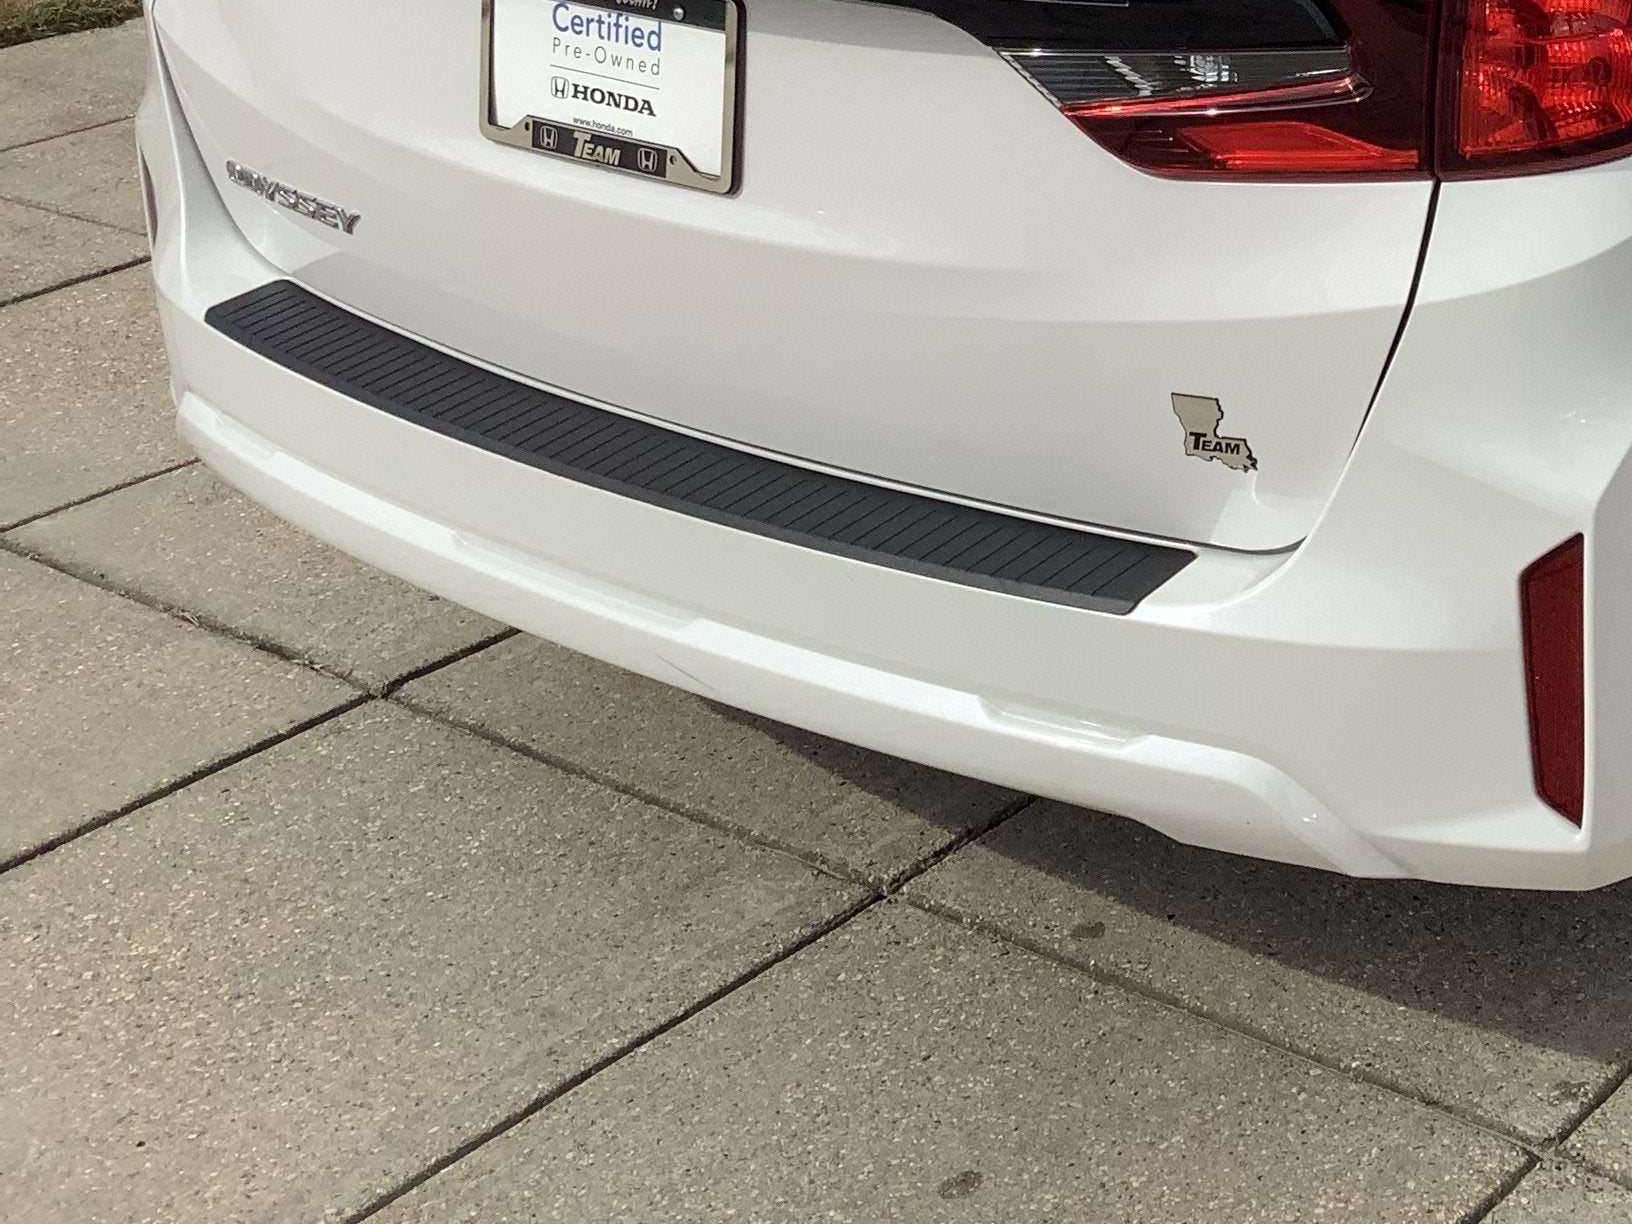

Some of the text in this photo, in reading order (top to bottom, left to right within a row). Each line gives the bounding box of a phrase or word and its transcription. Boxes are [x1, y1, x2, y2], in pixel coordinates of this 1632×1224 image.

[552, 2, 661, 52] Certified
[552, 36, 660, 76] Pre-Owned
[571, 82, 657, 117] HONDA
[572, 117, 633, 137] www.honda.com
[226, 160, 361, 235] ODYSSEY
